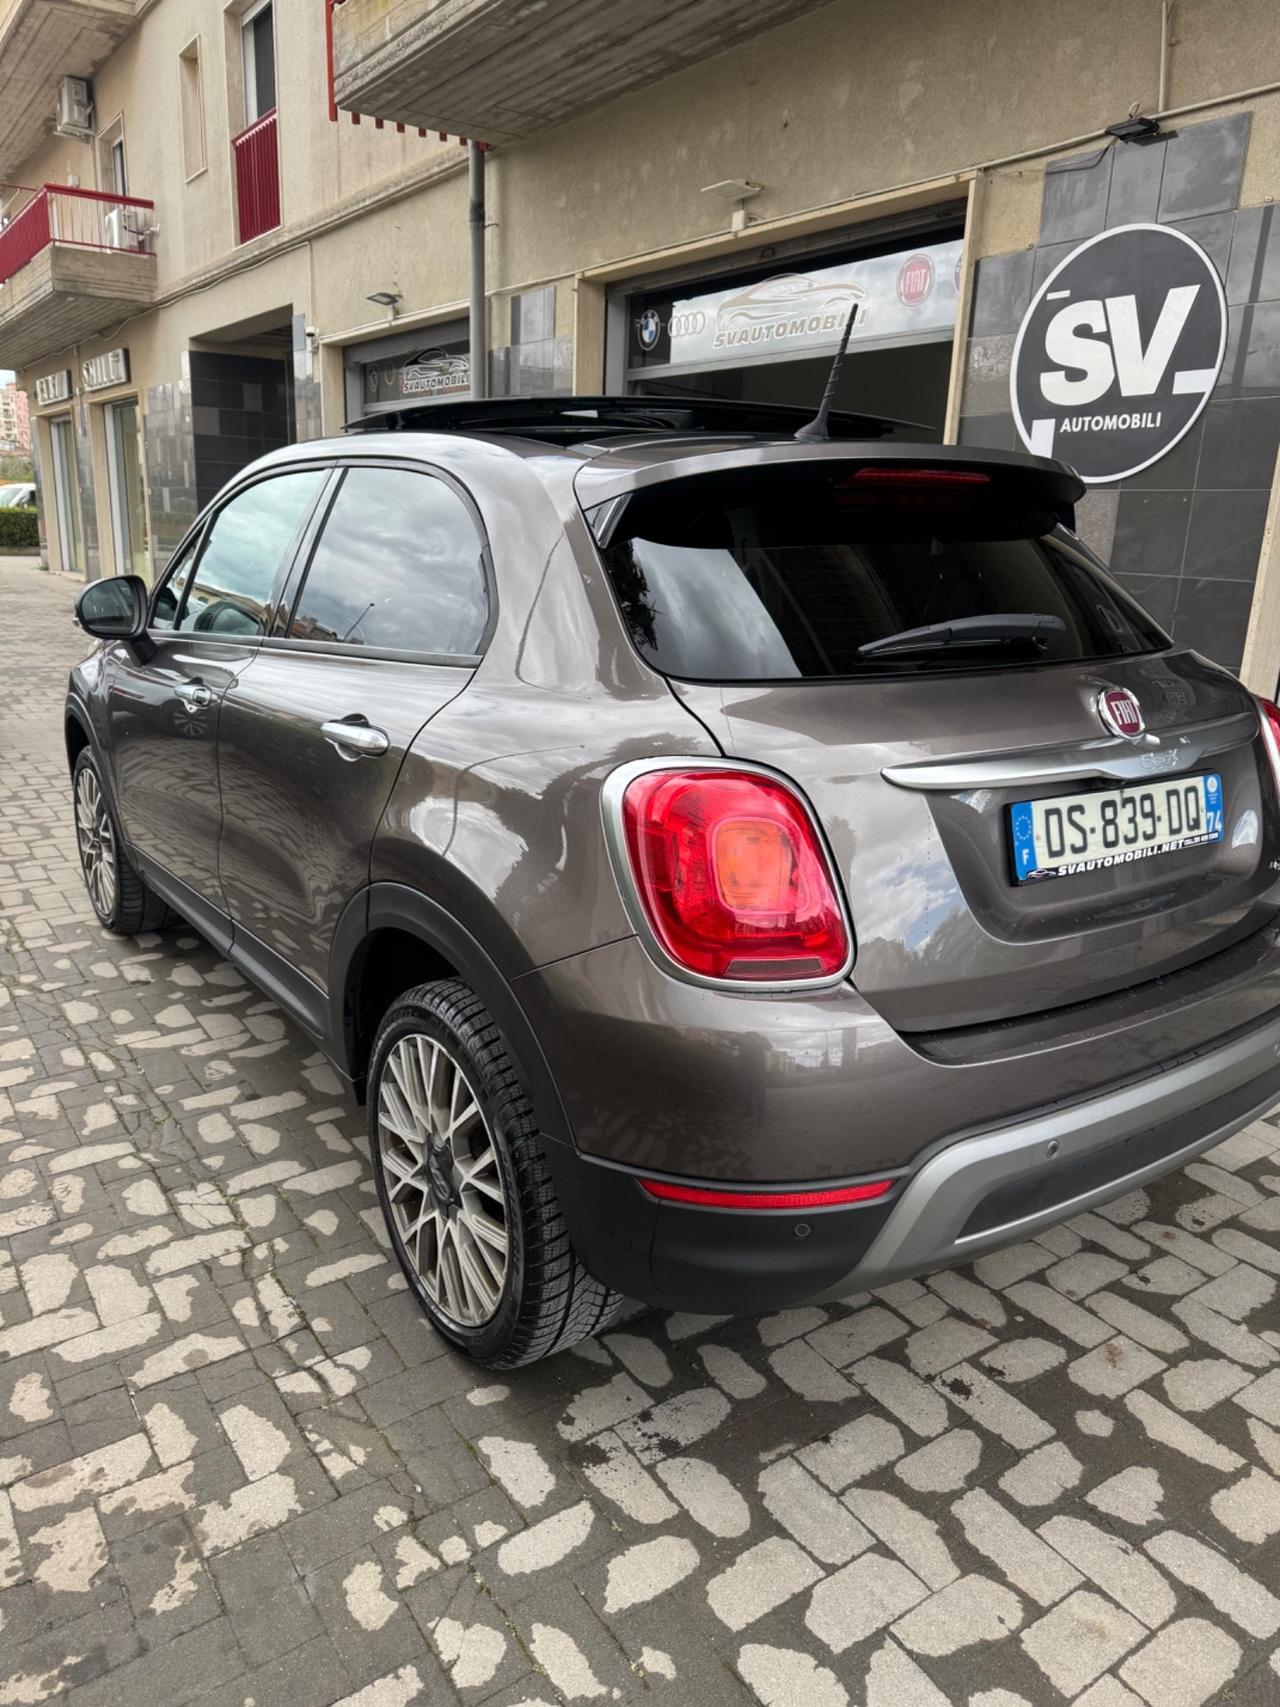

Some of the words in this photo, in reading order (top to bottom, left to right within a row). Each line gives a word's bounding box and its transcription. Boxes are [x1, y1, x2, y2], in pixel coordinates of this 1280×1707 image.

[905, 269, 927, 293] FIAT
[713, 308, 868, 348] SVAUTOMOBII
[1040, 284, 1201, 406] SV
[1060, 412, 1162, 433] AUTOMOBILI
[1110, 698, 1138, 726] FIAT
[1206, 811, 1223, 833] 74
[1021, 848, 1030, 865] F
[1057, 838, 1185, 877] SVAUTOMOBILI.NET
